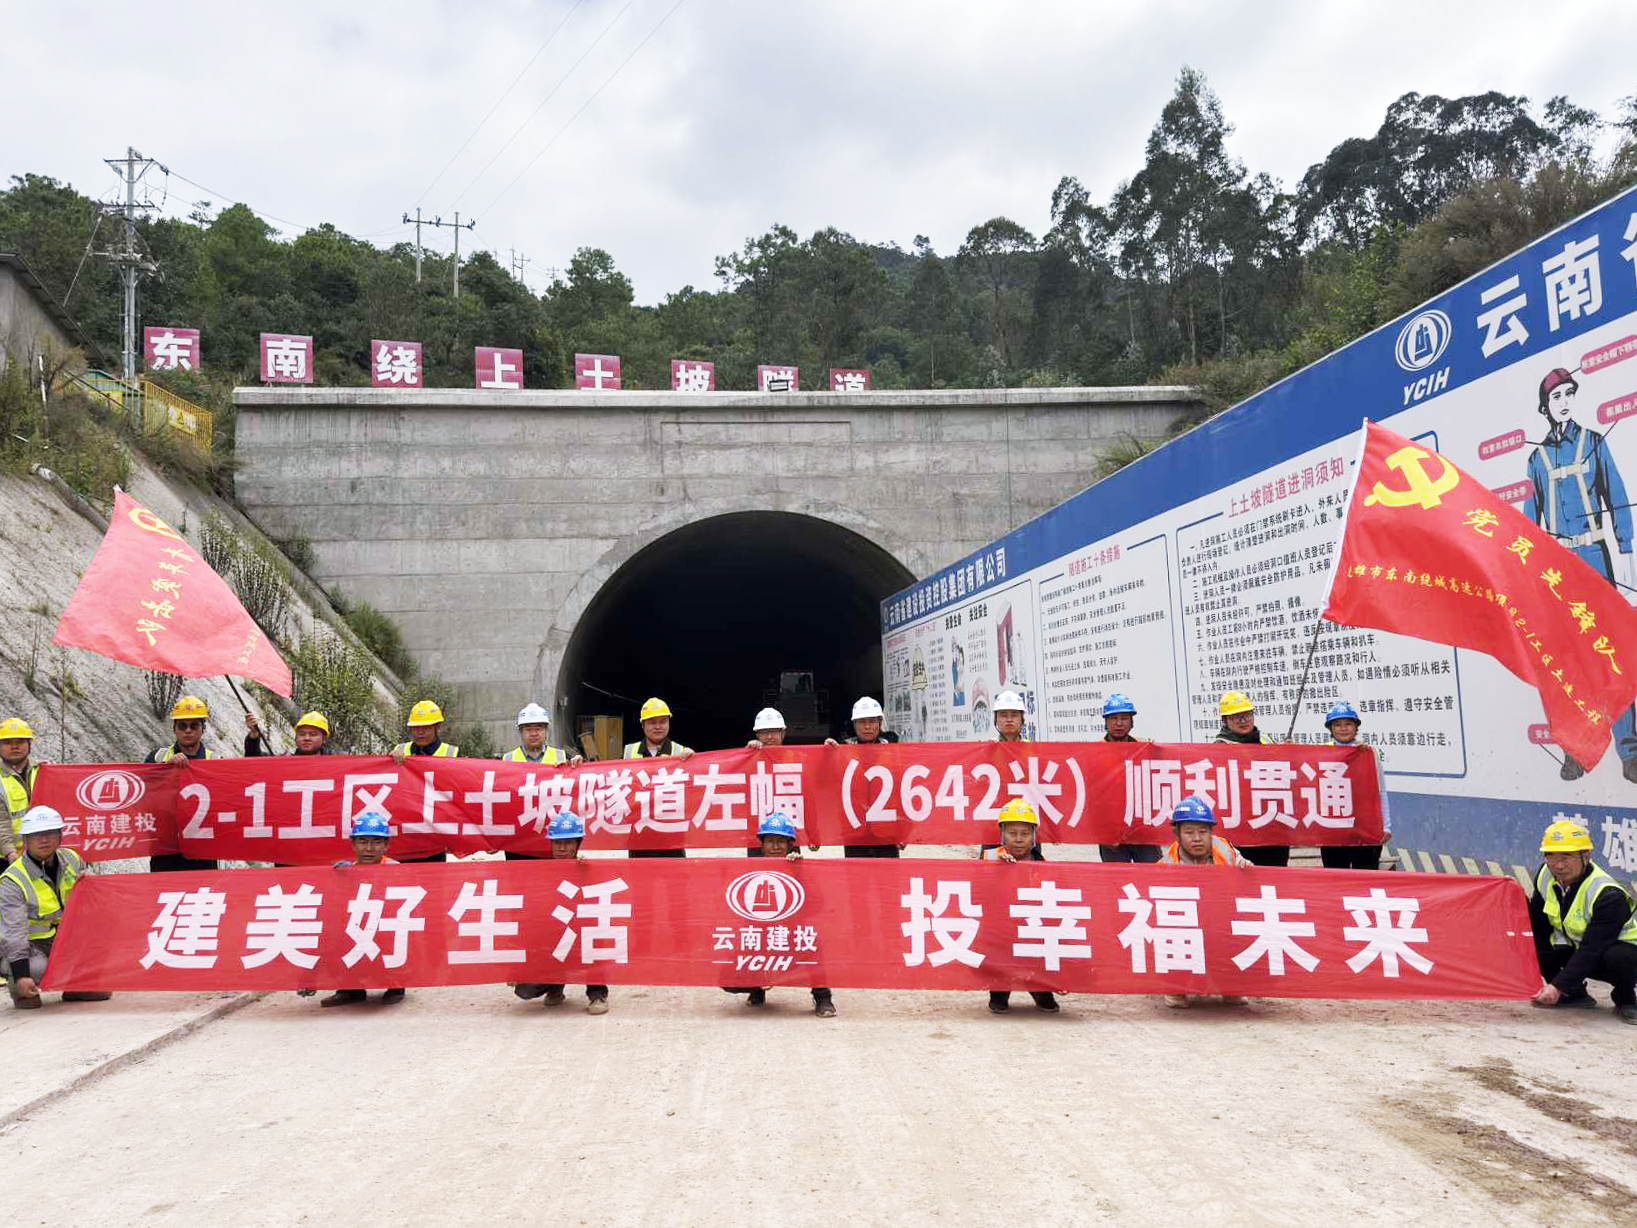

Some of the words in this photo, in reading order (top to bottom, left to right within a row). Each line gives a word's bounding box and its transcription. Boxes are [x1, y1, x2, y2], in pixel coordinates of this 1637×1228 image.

[1403, 367, 1450, 405] YCIH
[1229, 457, 1344, 518] 上土坡隧道进洞须知
[1463, 508, 1621, 675] 党员先锋队
[62, 813, 156, 836] 云南建投
[83, 836, 136, 852] YCIH
[1552, 812, 1637, 873] 雄
[140, 878, 632, 969] 建美好生活
[712, 925, 817, 952] 云南建投
[901, 878, 1434, 977] 投幸福未来
[735, 955, 793, 971] YCIH
